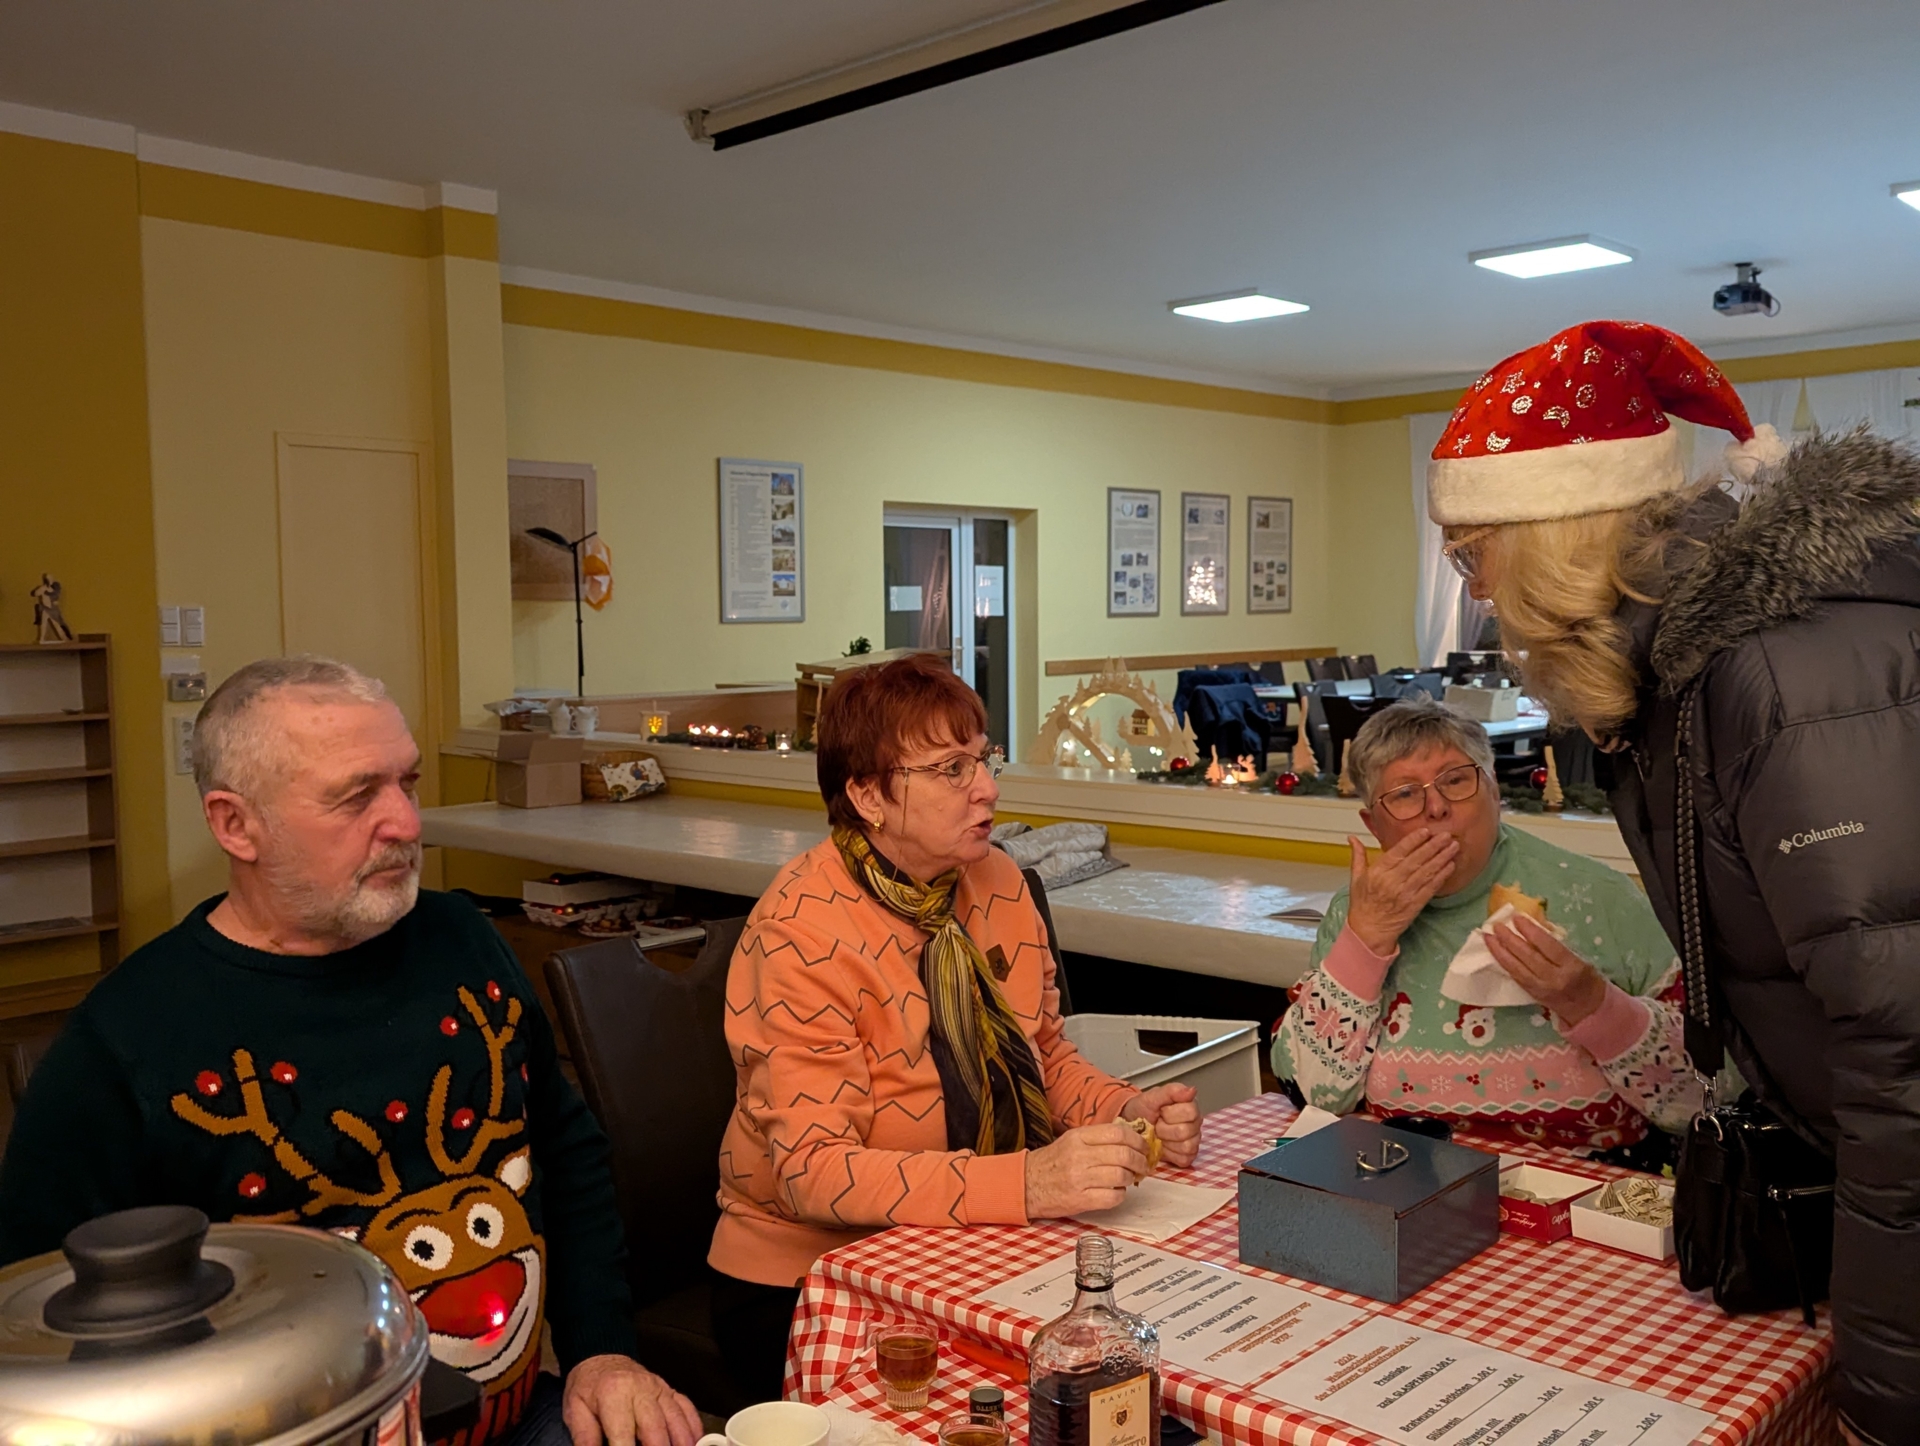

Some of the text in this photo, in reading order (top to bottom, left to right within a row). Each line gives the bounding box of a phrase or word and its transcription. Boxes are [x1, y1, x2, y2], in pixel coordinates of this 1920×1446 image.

[1792, 820, 1864, 848] Columbia
[1198, 1304, 1242, 1327] GLASPFAND
[1373, 1366, 1410, 1386] Preisliste
[1393, 1371, 1437, 1398] GLASPFAND
[1100, 1386, 1142, 1405] RAVINI
[1399, 1408, 1440, 1432] Bratwurst
[1440, 1384, 1474, 1405] Brötchen
[1426, 1418, 1464, 1440] Glühwein
[1486, 1418, 1501, 1428] mit
[1537, 1429, 1566, 1446] felsaft
[1589, 1430, 1605, 1439] mit
